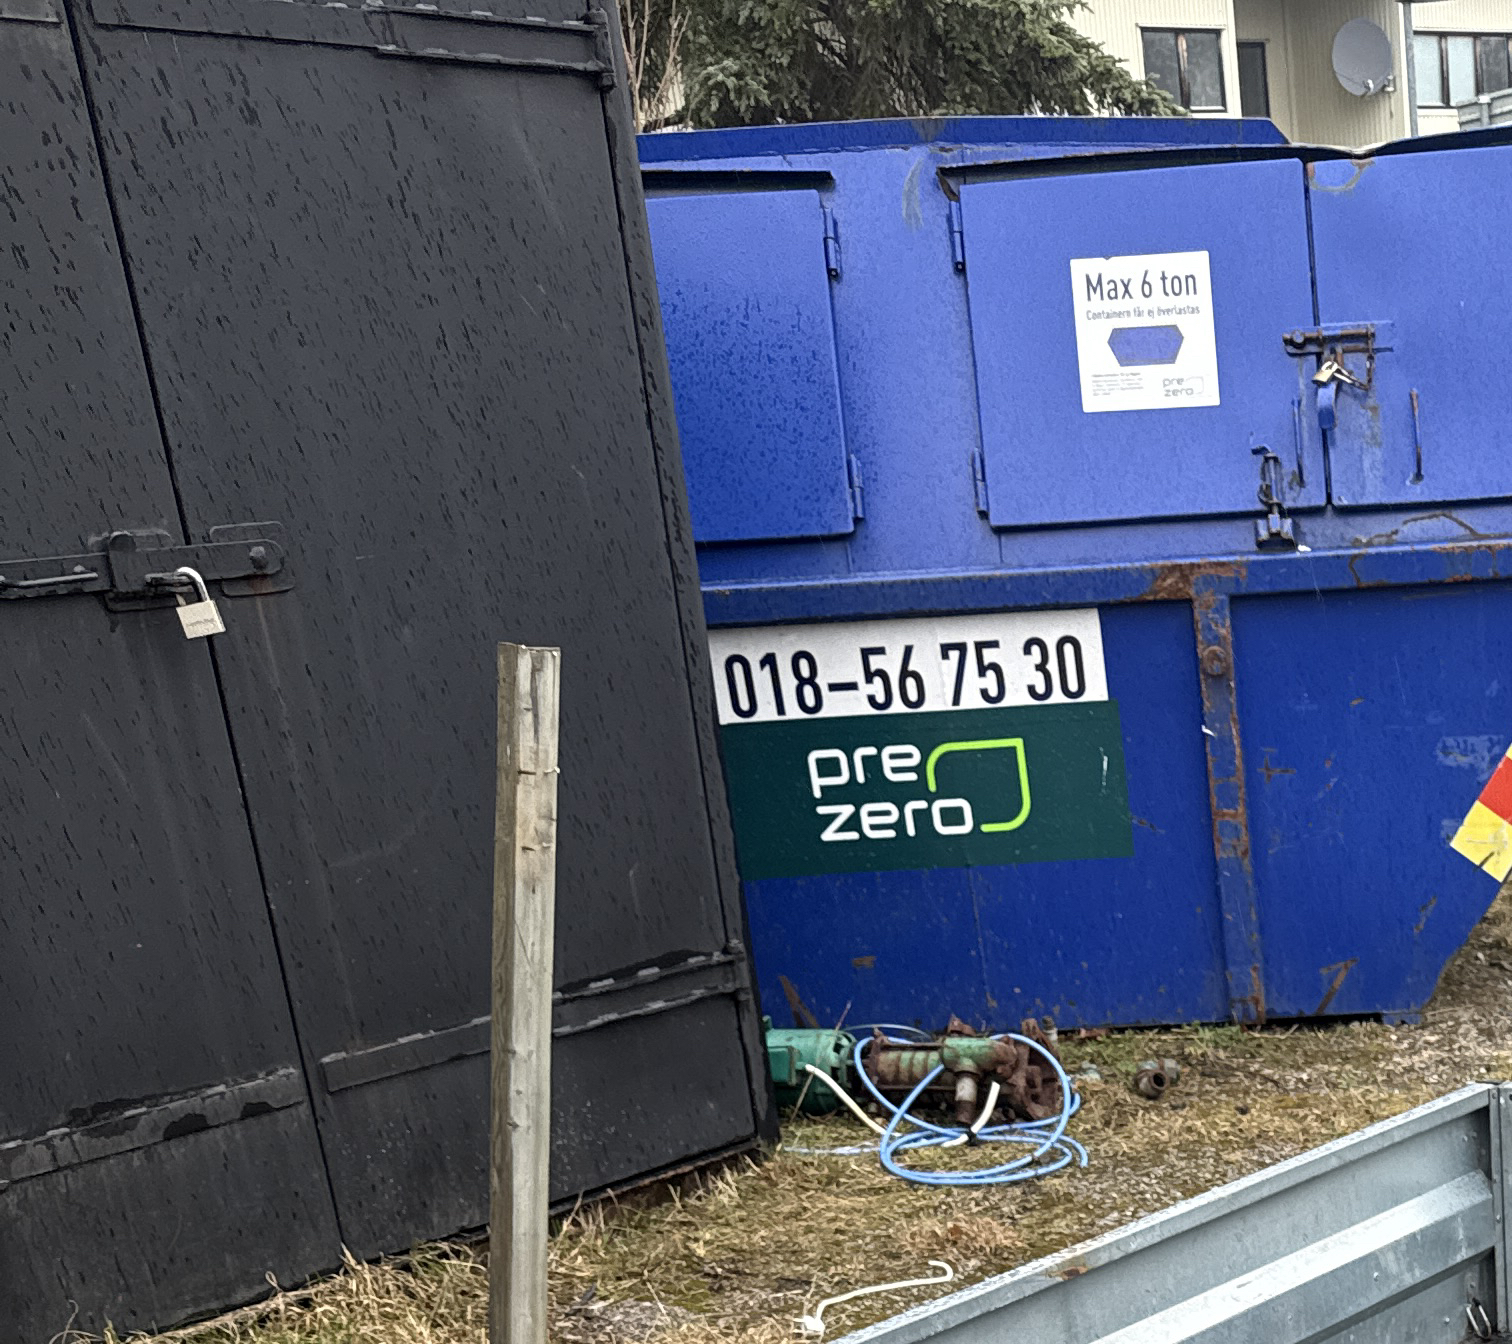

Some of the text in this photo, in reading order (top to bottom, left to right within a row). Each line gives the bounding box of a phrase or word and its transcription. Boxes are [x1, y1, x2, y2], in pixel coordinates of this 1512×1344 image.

[1085, 269, 1198, 302] Max 6 ton
[1147, 307, 1155, 319] ej
[1162, 377, 1185, 388] pre
[1164, 387, 1194, 398] zero
[940, 639, 1006, 706] 75
[1023, 635, 1087, 701] 30
[807, 743, 922, 799] pre
[815, 797, 974, 842] zero
